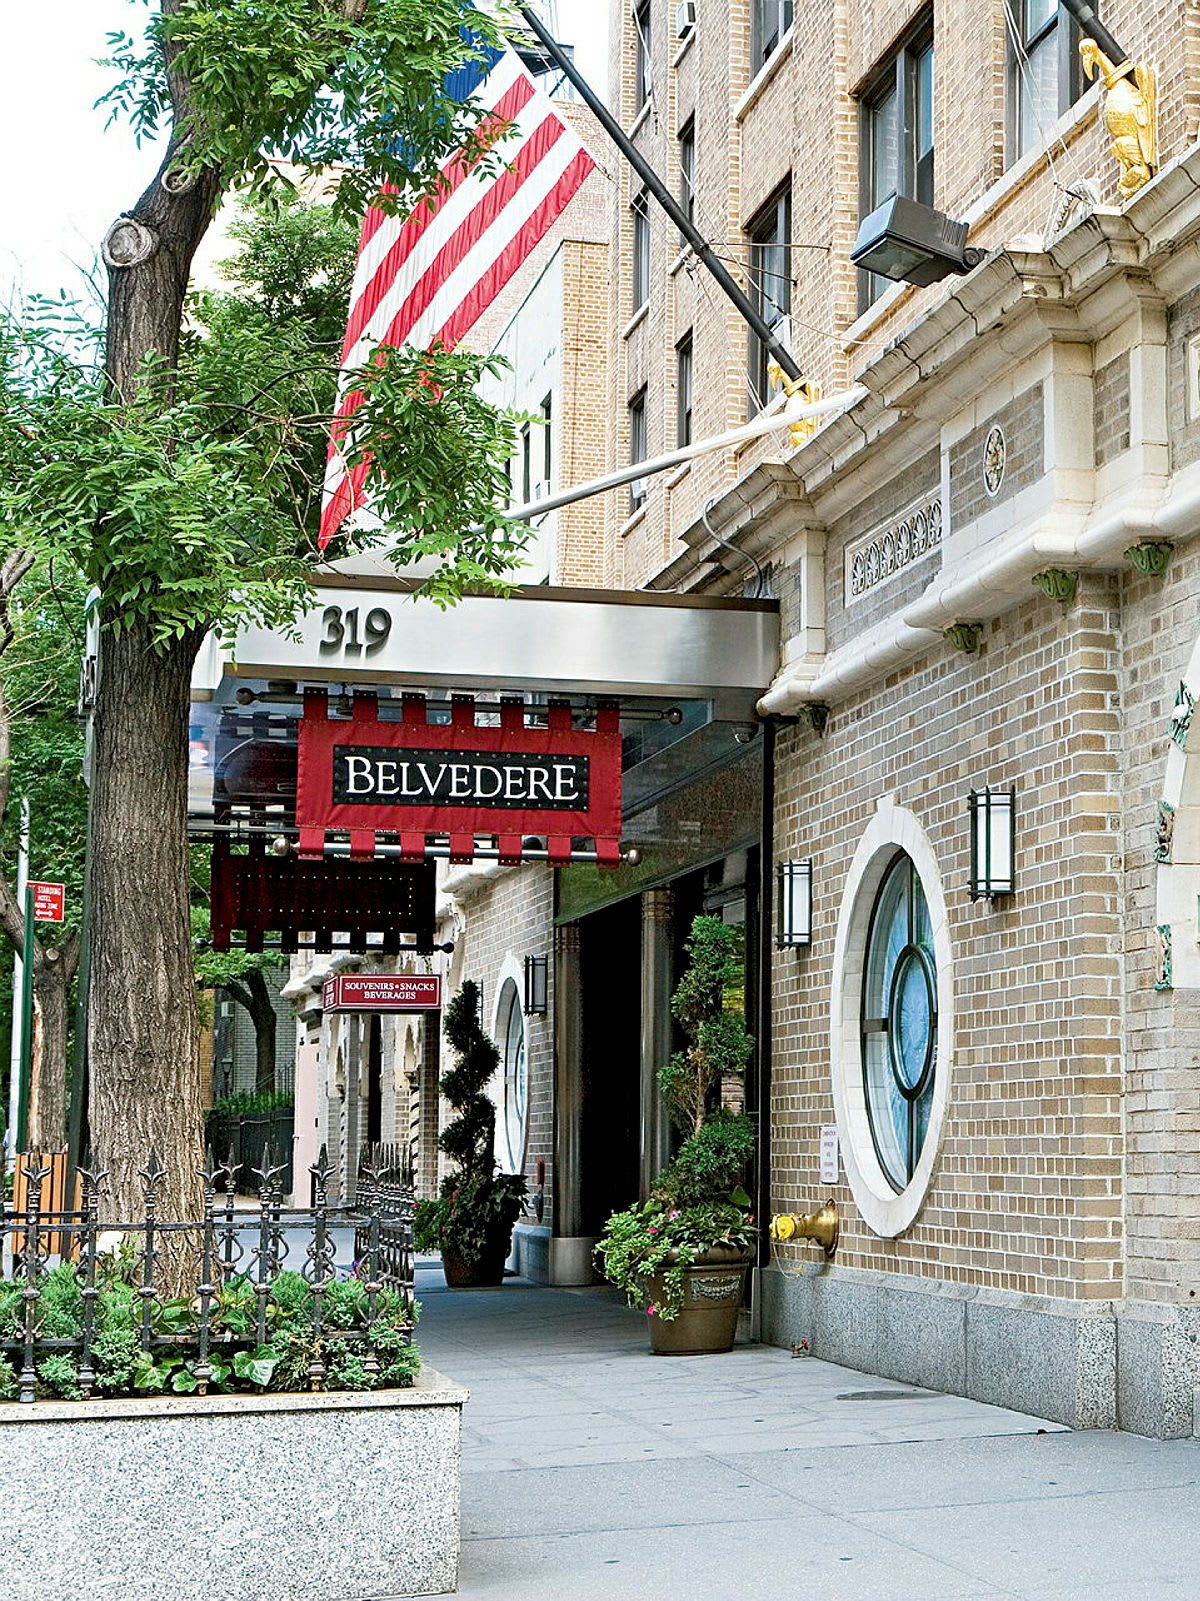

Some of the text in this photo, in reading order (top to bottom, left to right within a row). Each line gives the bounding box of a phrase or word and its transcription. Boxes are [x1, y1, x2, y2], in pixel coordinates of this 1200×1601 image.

[319, 604, 392, 658] 319
[344, 755, 579, 801] BELVEDERE
[344, 982, 435, 991] SOUVENIRS SNACKS
[363, 991, 416, 1000] BEVERAGES
